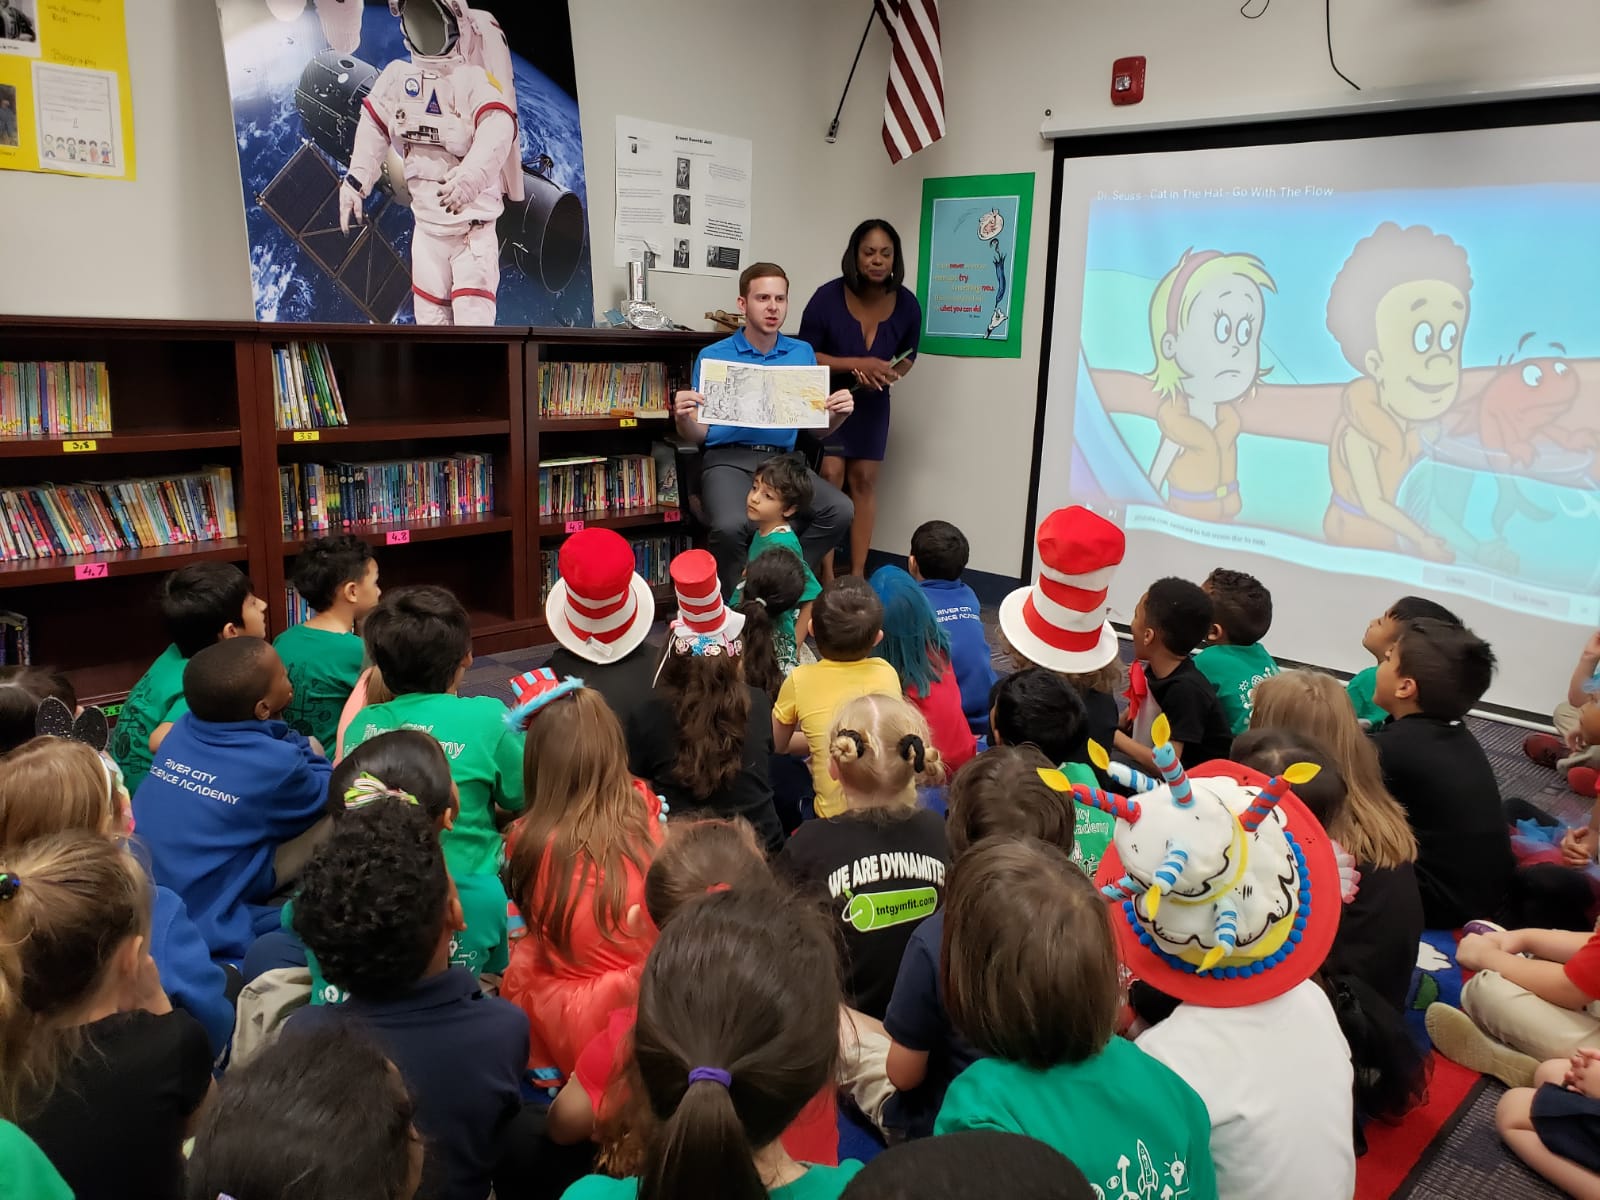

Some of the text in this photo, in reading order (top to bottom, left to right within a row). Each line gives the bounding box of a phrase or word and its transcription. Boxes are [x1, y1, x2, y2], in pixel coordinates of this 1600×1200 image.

[1150, 188, 1168, 200] Cat
[1169, 189, 1180, 200] in
[1183, 188, 1201, 200] The
[1204, 187, 1223, 199] Hat
[1232, 186, 1248, 198] Go
[1250, 186, 1277, 199] With
[1280, 186, 1301, 198] The
[1304, 185, 1335, 198] Flow
[82, 564, 105, 577] 4.7
[164, 758, 217, 784] RIVER CITY
[179, 778, 240, 806] ACADEMY
[828, 864, 851, 899] WE
[852, 855, 880, 888] ARE
[876, 896, 935, 916] tntgymfit.com
